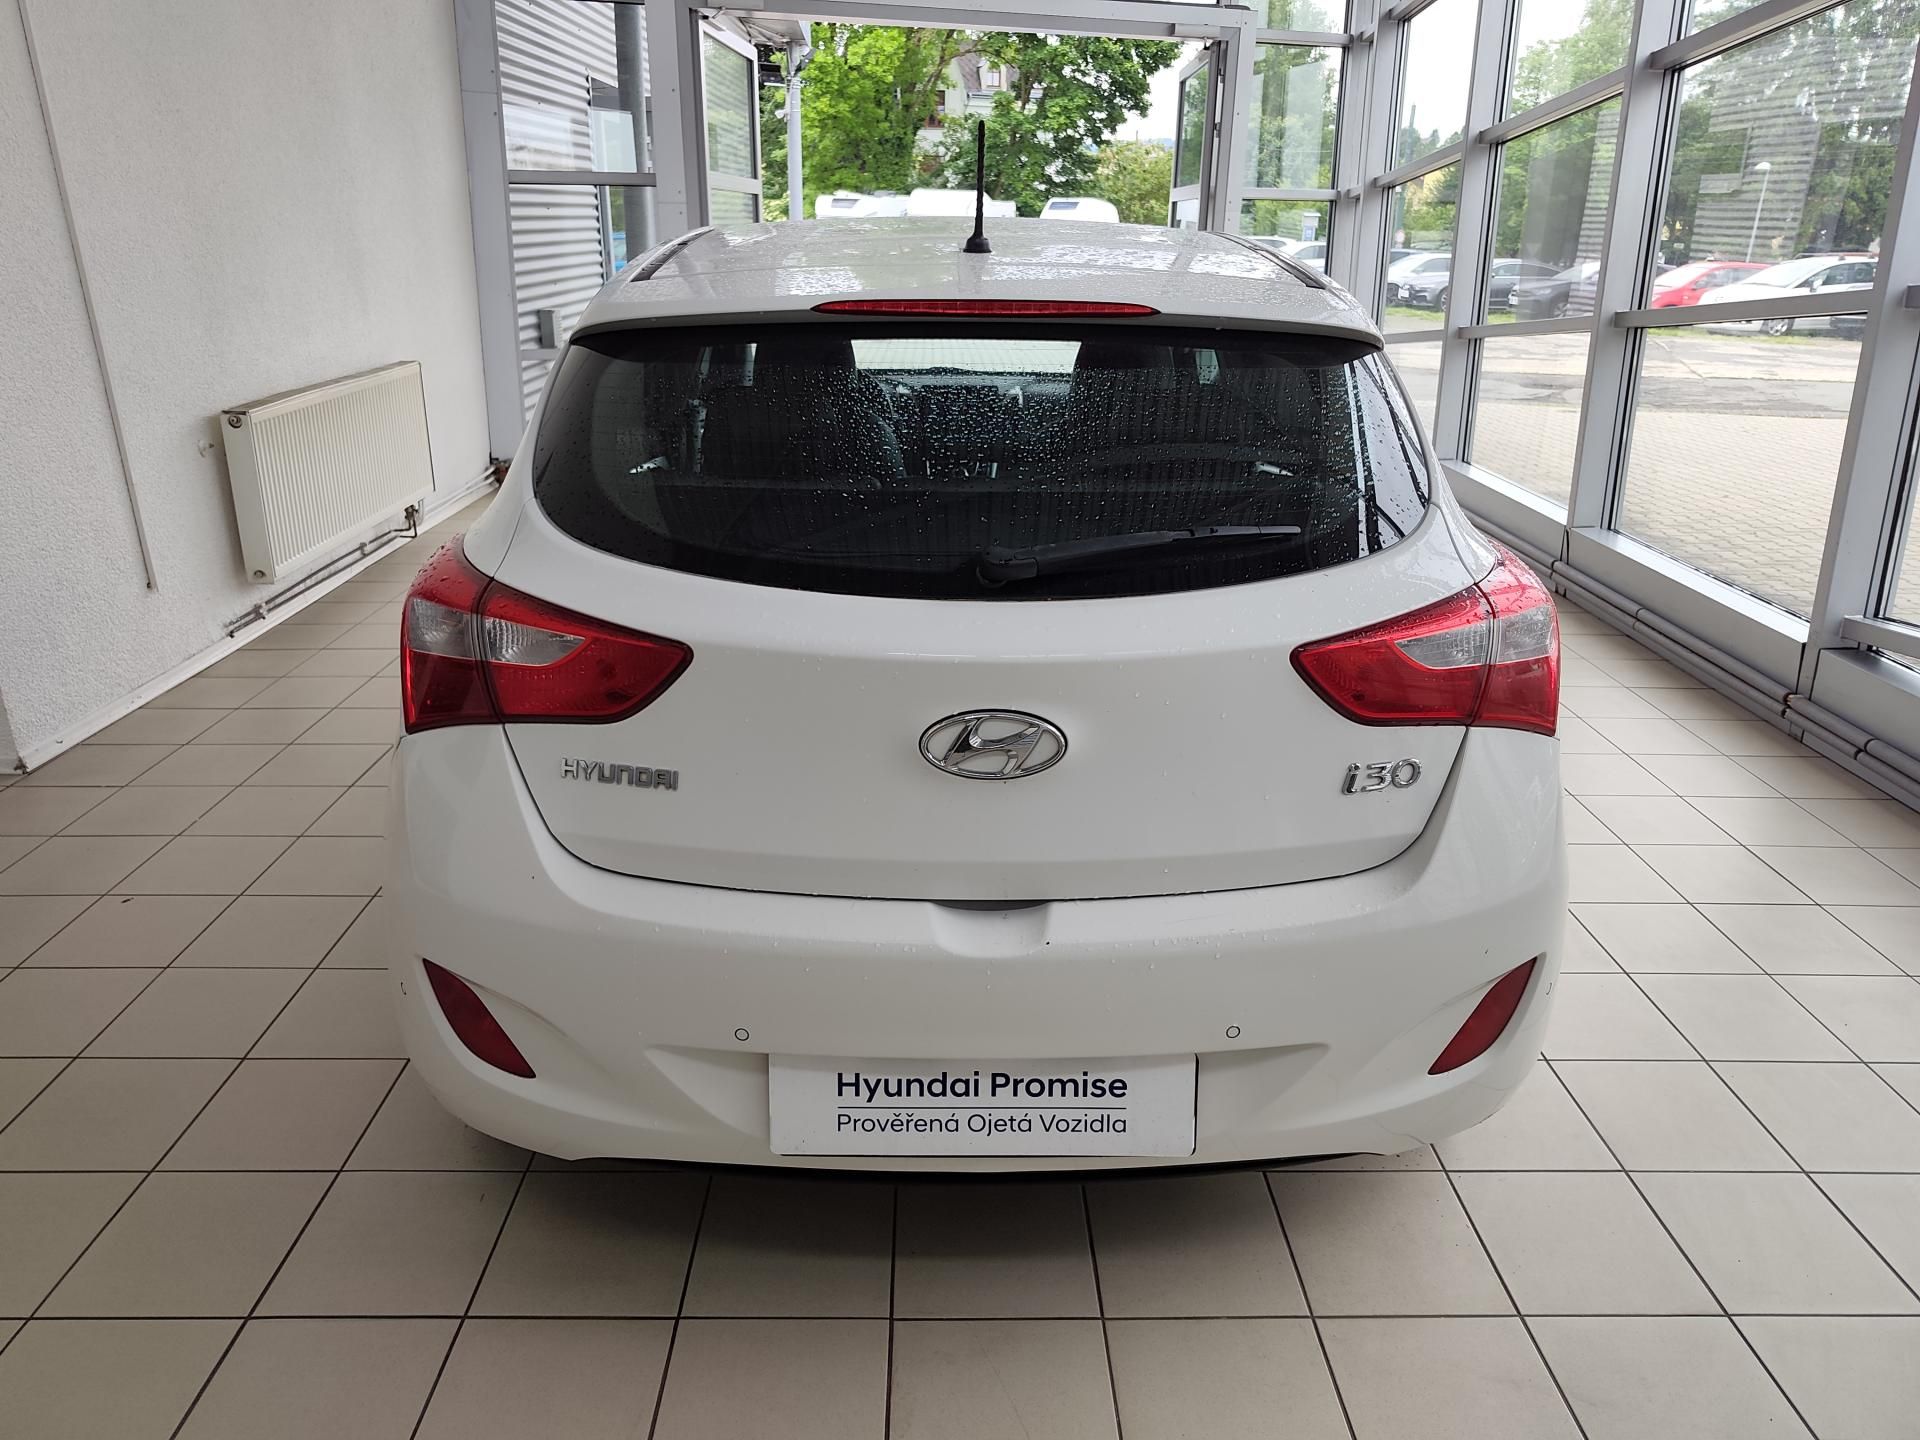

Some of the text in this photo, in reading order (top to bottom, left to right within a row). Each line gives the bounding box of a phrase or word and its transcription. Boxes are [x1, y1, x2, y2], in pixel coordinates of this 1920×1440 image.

[561, 758, 679, 791] HYUNDAI
[1341, 758, 1421, 795] i30
[837, 1070, 1128, 1104] Hyundai Promise
[837, 1112, 1127, 1137] Prověřená Ojetá Vozidla
